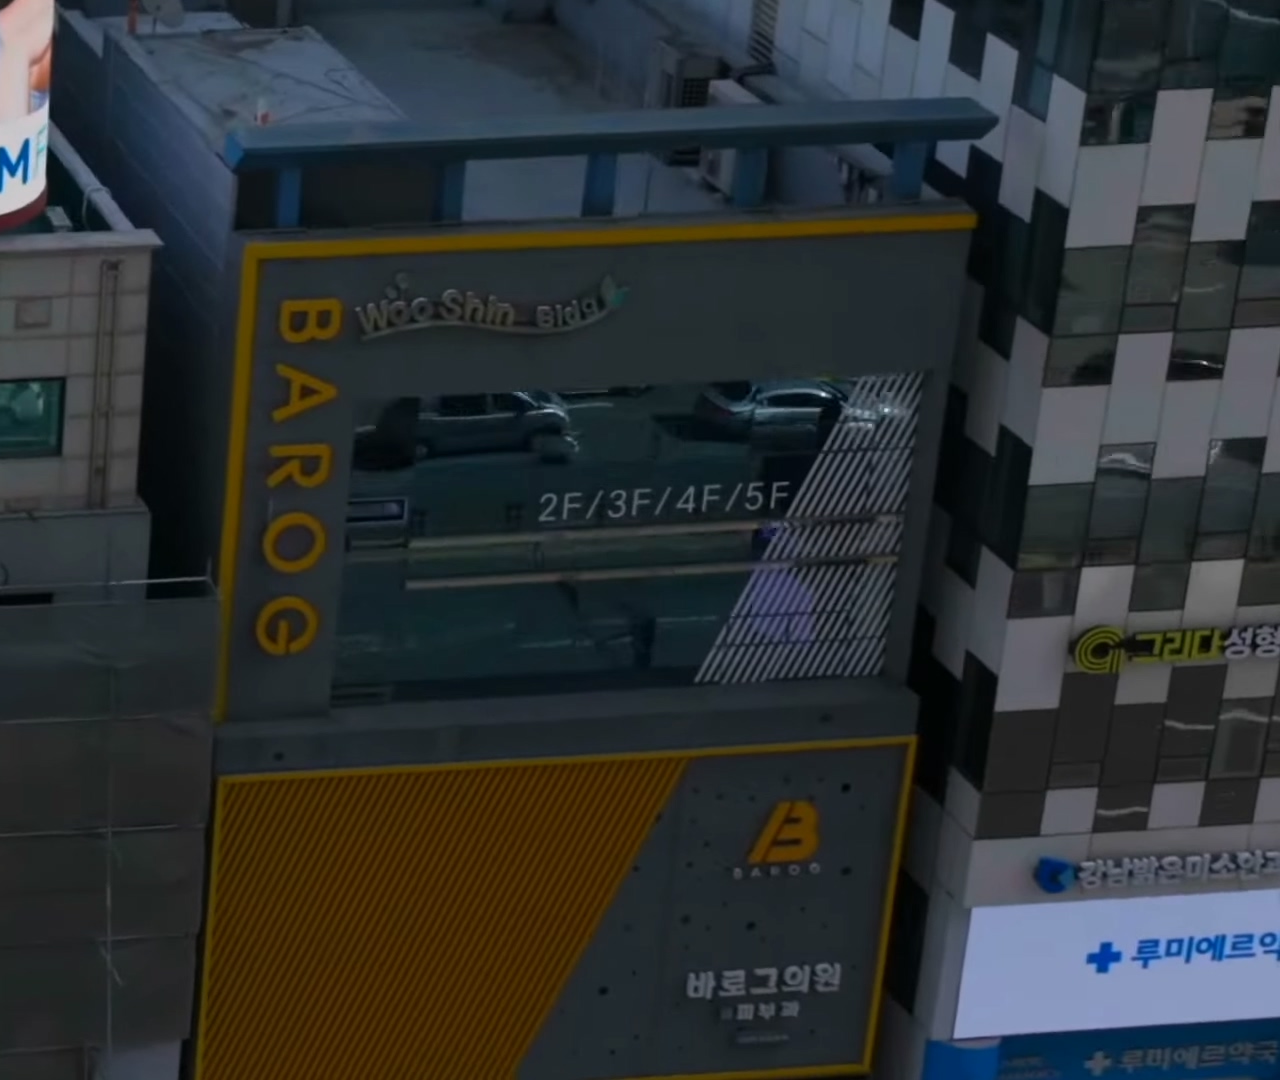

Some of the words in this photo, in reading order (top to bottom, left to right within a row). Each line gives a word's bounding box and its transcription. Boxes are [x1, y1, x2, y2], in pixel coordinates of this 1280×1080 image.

[355, 297, 434, 333] Woo
[439, 288, 516, 327] Shin
[256, 296, 343, 658] BAROG
[538, 481, 791, 522] 2F/3F/4F/5F
[686, 962, 842, 999] 바로그의원
[736, 1000, 800, 1020] 피부과
[1119, 1039, 1280, 1074] 루미에르약국
